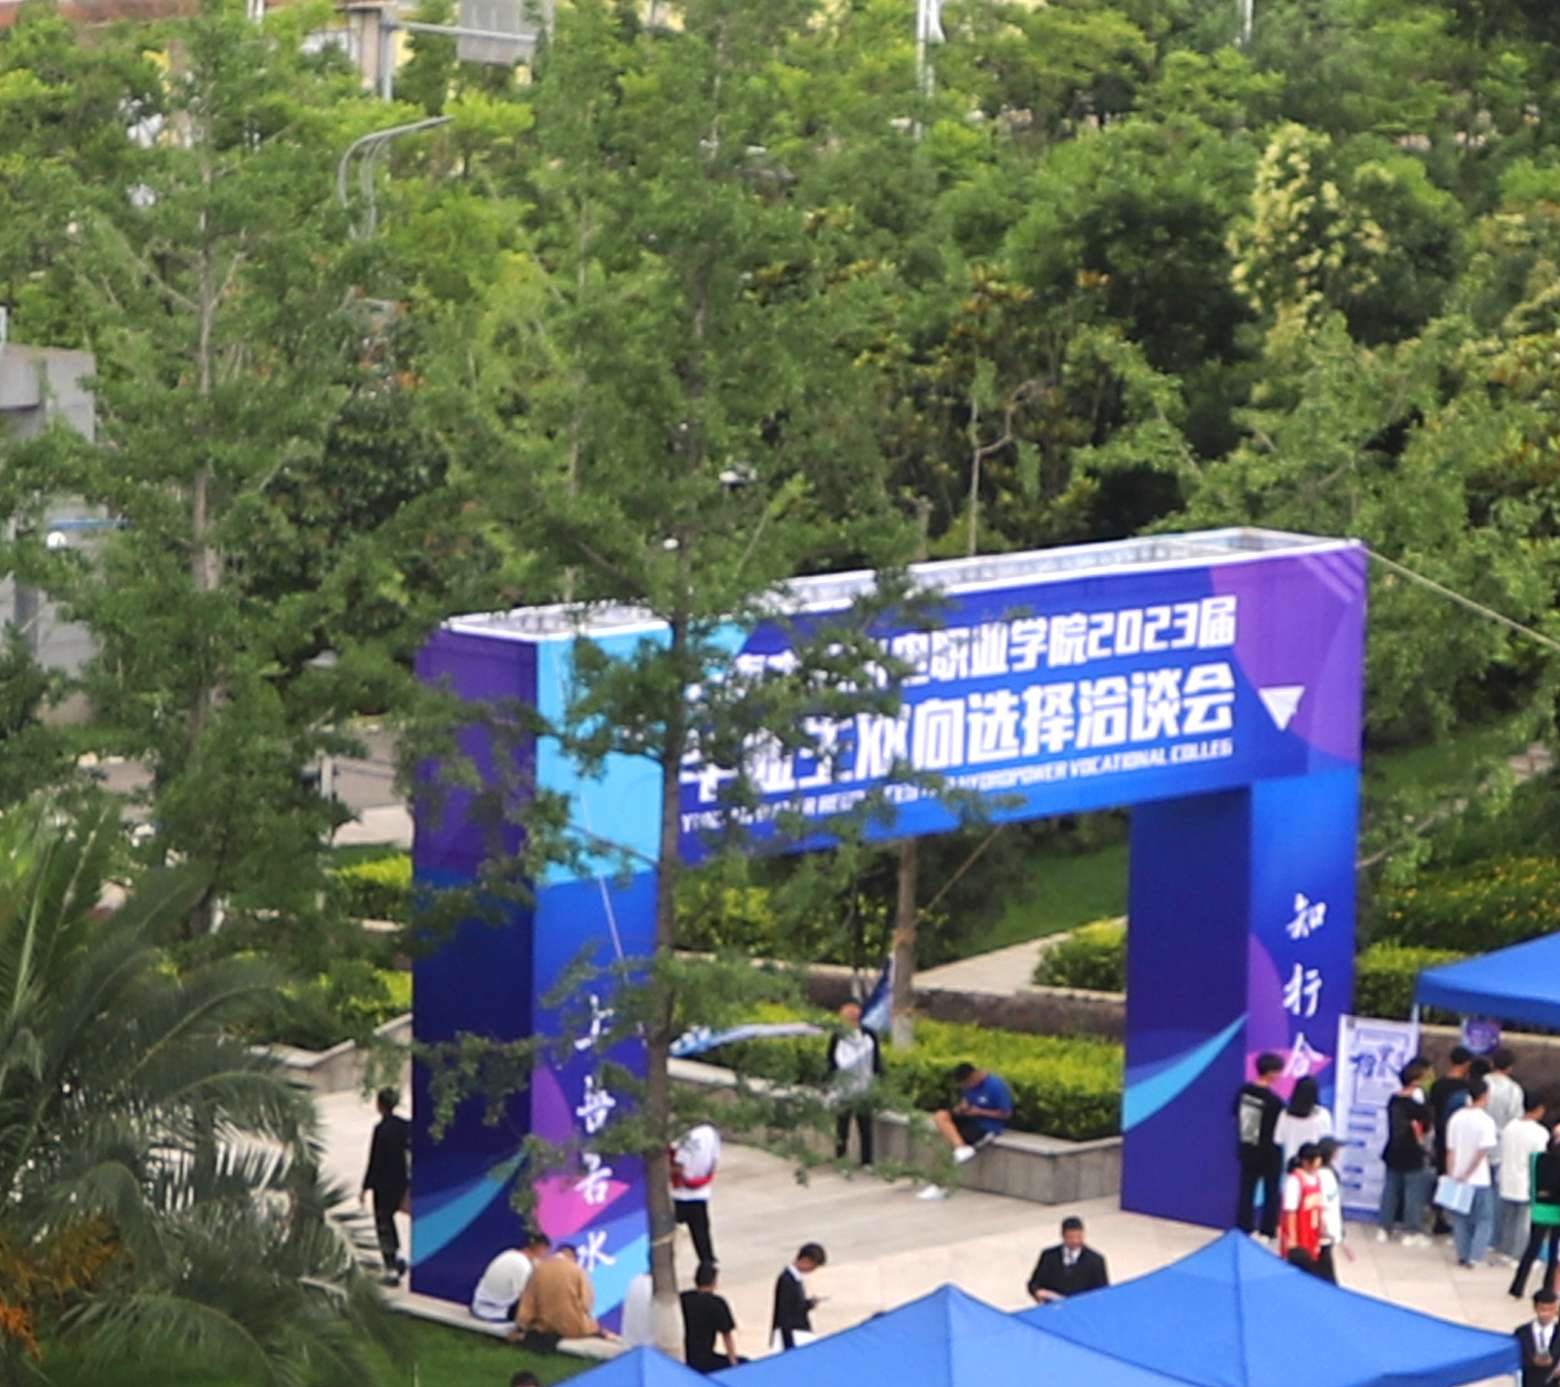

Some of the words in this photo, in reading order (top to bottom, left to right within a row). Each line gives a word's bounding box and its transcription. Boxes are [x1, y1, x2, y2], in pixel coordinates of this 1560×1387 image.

[683, 595, 1237, 700] 电职业学院2023届
[1071, 749, 1168, 778] VOCATIONAL
[1171, 738, 1233, 763] COLLEG
